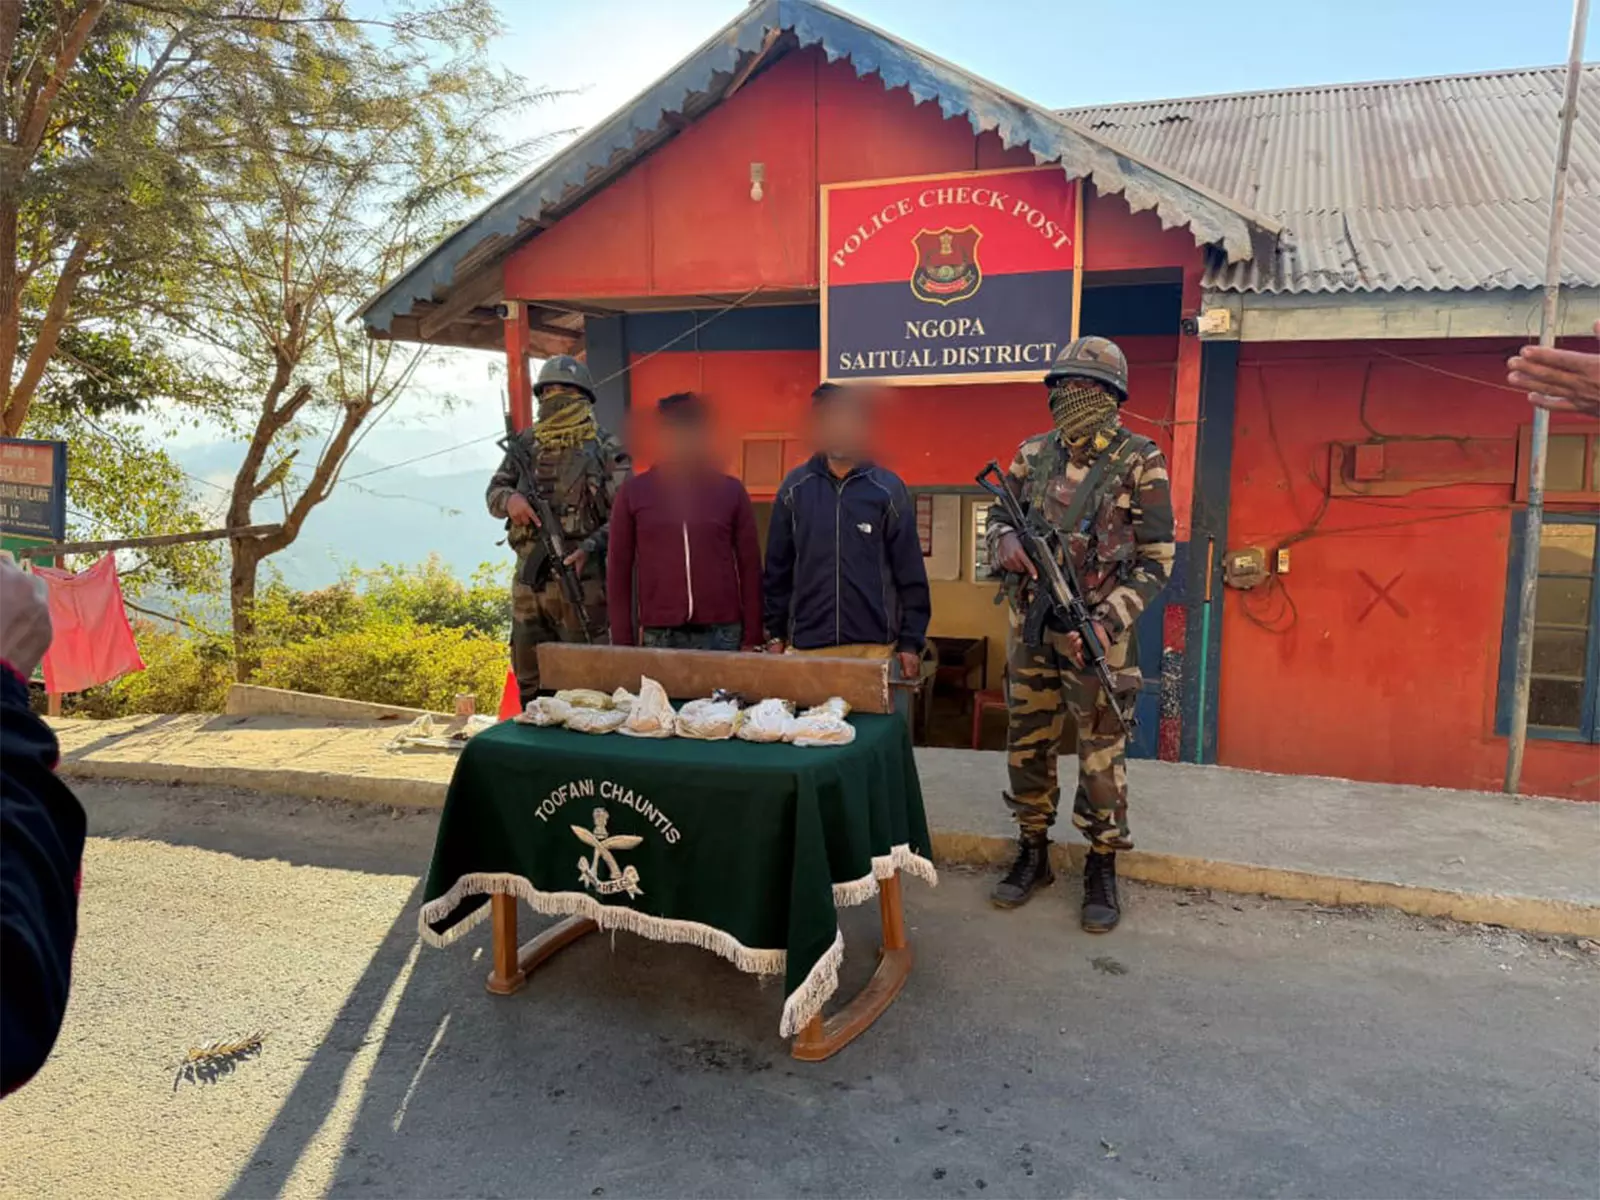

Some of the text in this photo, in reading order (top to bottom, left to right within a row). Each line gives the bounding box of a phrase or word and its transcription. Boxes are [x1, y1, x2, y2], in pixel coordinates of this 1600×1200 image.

[832, 187, 1072, 267] POLICE CHECK POST
[905, 317, 985, 339] NGOPA
[839, 343, 1056, 370] SAITUAL DISTRICT
[534, 779, 681, 844] TOOFANI CHAUNTIS
